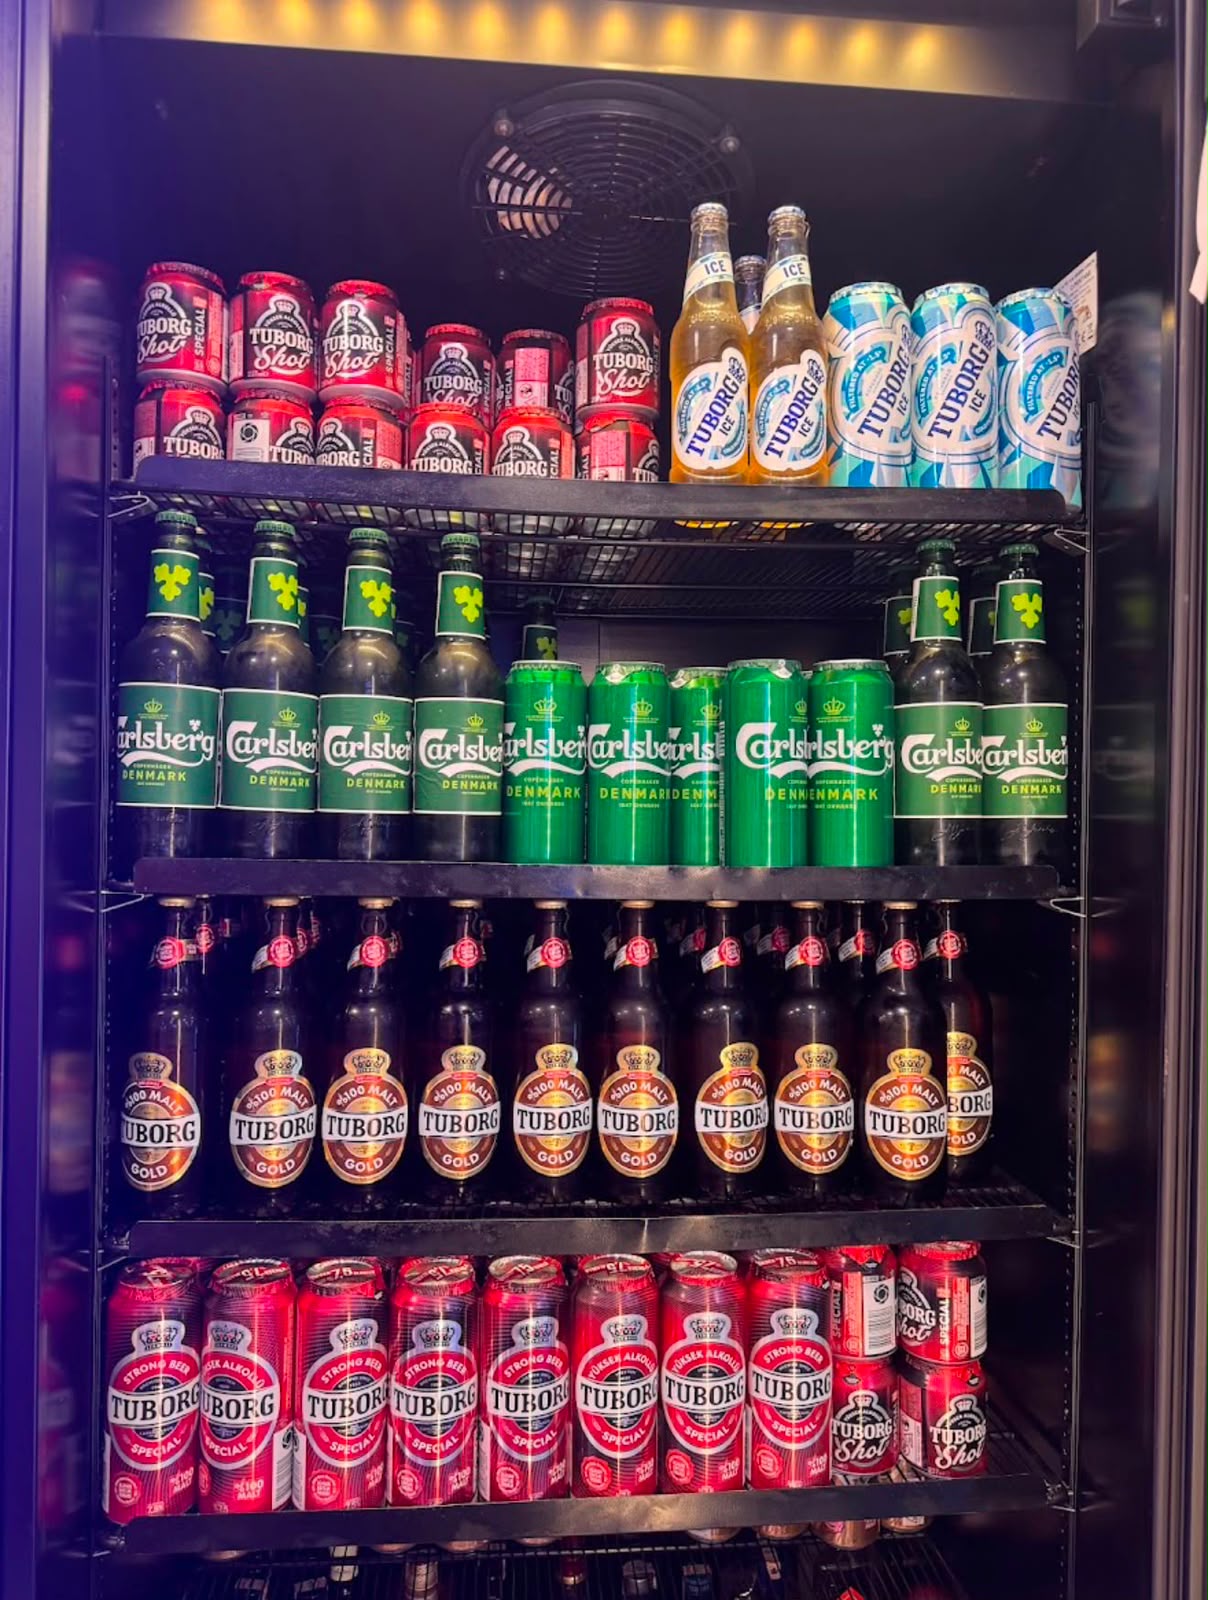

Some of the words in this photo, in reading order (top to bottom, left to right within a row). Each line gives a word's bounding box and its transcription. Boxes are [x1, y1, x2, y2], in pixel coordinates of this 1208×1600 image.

[704, 260, 726, 275] ICE
[783, 263, 805, 278] ICE
[194, 308, 206, 356] SPECIAL
[250, 328, 313, 355] TUBORG
[137, 334, 188, 364] Shot
[322, 333, 384, 354] TUBORG
[385, 327, 394, 373] SPECIAL
[254, 344, 311, 370] Shot
[325, 350, 380, 378] Shot
[593, 352, 653, 373] TUBORG
[424, 375, 482, 395] TUBORG
[599, 368, 650, 395] Shot
[848, 371, 859, 409] FILTERED
[857, 361, 866, 371] AT
[920, 376, 929, 413] FILTERED
[927, 364, 936, 376] AT
[927, 342, 990, 439] TUBORG
[1026, 374, 1039, 411] FILTERED
[1036, 364, 1046, 374] AT
[897, 393, 909, 417] ICE
[968, 389, 987, 413] ICE
[685, 375, 739, 458] TUBORG
[719, 415, 736, 437] ICE
[764, 377, 819, 459] TUBORG
[798, 416, 814, 438] ICE
[411, 456, 473, 474] TUBORG
[492, 460, 548, 477] TUBORG
[123, 769, 187, 781] DENMARK
[347, 778, 405, 790] DENMARK
[442, 780, 498, 790] DENMARK
[506, 785, 581, 799] DENMARK
[1002, 785, 1061, 794] DENMARK
[959, 1065, 985, 1087] MALT
[246, 1089, 276, 1110] %100
[280, 1086, 309, 1107] MALT
[336, 1086, 365, 1107] %100
[368, 1084, 397, 1106] MALT
[434, 1082, 463, 1103] %100
[466, 1082, 492, 1103] MALT
[527, 1080, 555, 1100] %100
[558, 1079, 585, 1100] MALT
[610, 1081, 638, 1101] %100
[640, 1081, 668, 1103] MALT
[711, 1078, 740, 1100] %100
[742, 1077, 763, 1098] MALT
[788, 1080, 816, 1100] %100
[819, 1079, 846, 1101] MALT
[879, 1084, 908, 1105] %100
[912, 1083, 939, 1107] MALT
[149, 1090, 184, 1115] MALT
[235, 1113, 314, 1141] TUBORG
[327, 1113, 405, 1138] TUBORG
[424, 1109, 498, 1133] TUBORG
[517, 1106, 590, 1130] TUBORG
[602, 1109, 675, 1132] TUBORG
[779, 1106, 852, 1129] TUBORG
[869, 1110, 945, 1135] TUBORG
[122, 1120, 196, 1144] UBORG
[948, 1131, 976, 1145] OLD
[345, 1157, 383, 1172] GOLD
[442, 1152, 480, 1167] GOLD
[537, 1150, 574, 1165] GOLD
[620, 1152, 657, 1166] GOLD
[724, 1147, 757, 1162] GOLD
[801, 1148, 837, 1162] GOLD
[891, 1154, 929, 1168] GOLD
[131, 1163, 168, 1179] GOLD
[256, 1159, 296, 1176] GOLD
[900, 1321, 933, 1341] hot
[939, 1299, 949, 1345] SPECIAL
[763, 1344, 803, 1365] STRONG
[804, 1345, 824, 1364] BEER
[124, 1360, 166, 1385] STRONG
[169, 1360, 191, 1376] BEER
[322, 1357, 363, 1384] STRONG
[365, 1357, 383, 1373] BEER
[405, 1359, 445, 1380] STRONG
[446, 1359, 467, 1376] BEER
[504, 1355, 544, 1378] STRONG
[546, 1355, 563, 1370] BEER
[665, 1375, 744, 1406] TUBORG
[753, 1371, 832, 1402] TUBORG
[111, 1382, 199, 1421] TUBORG
[394, 1383, 476, 1417] TUBORG
[512, 1430, 558, 1449] SPECIAL
[602, 1427, 646, 1446] SPECIAL
[684, 1425, 730, 1443] SPECIAL
[771, 1421, 817, 1438] SPECIAL
[832, 1418, 893, 1440] TUBORG
[131, 1436, 181, 1457] SPECIAL
[330, 1433, 376, 1454] SPECIAL
[412, 1435, 459, 1454] SPECIAL
[834, 1436, 890, 1462] Shot
[935, 1438, 985, 1470] Shot
